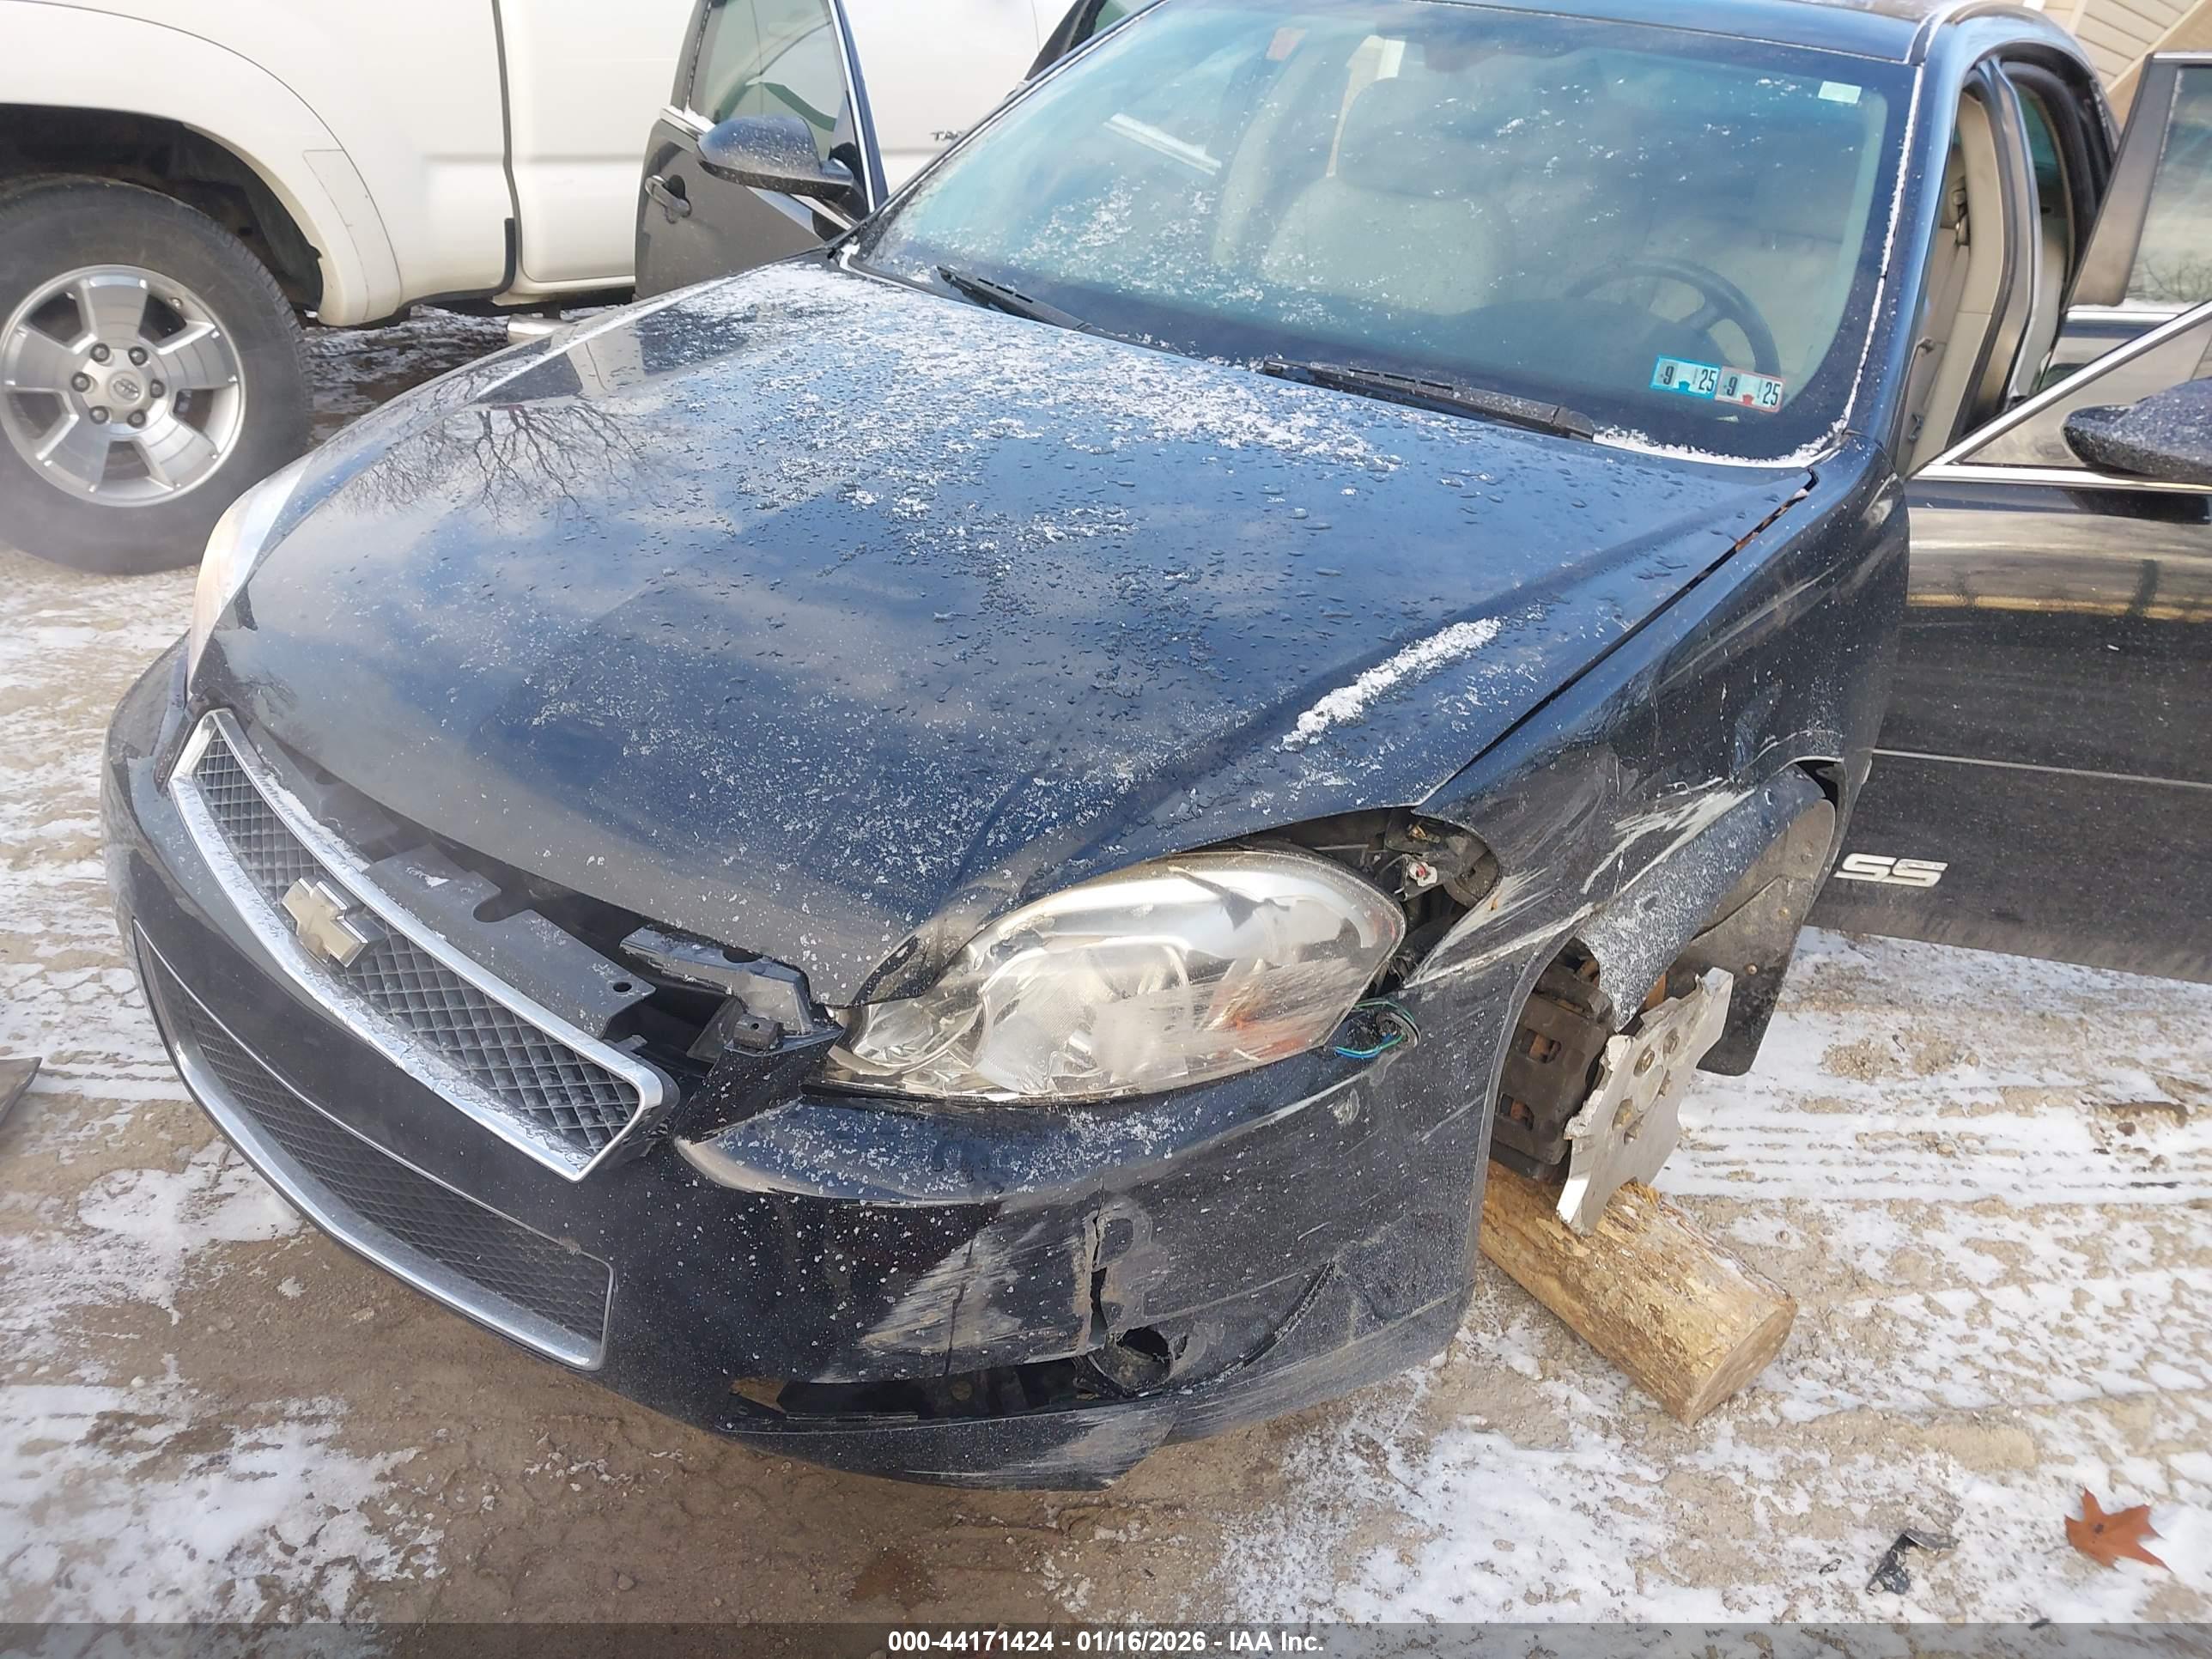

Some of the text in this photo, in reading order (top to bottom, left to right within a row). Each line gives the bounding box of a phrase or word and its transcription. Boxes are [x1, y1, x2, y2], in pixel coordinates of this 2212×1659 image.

[1663, 366, 1674, 385] 9
[1698, 368, 1717, 392] 25
[1727, 376, 1738, 396] 9
[1762, 381, 1781, 406] 25
[1834, 853, 1948, 887] SS
